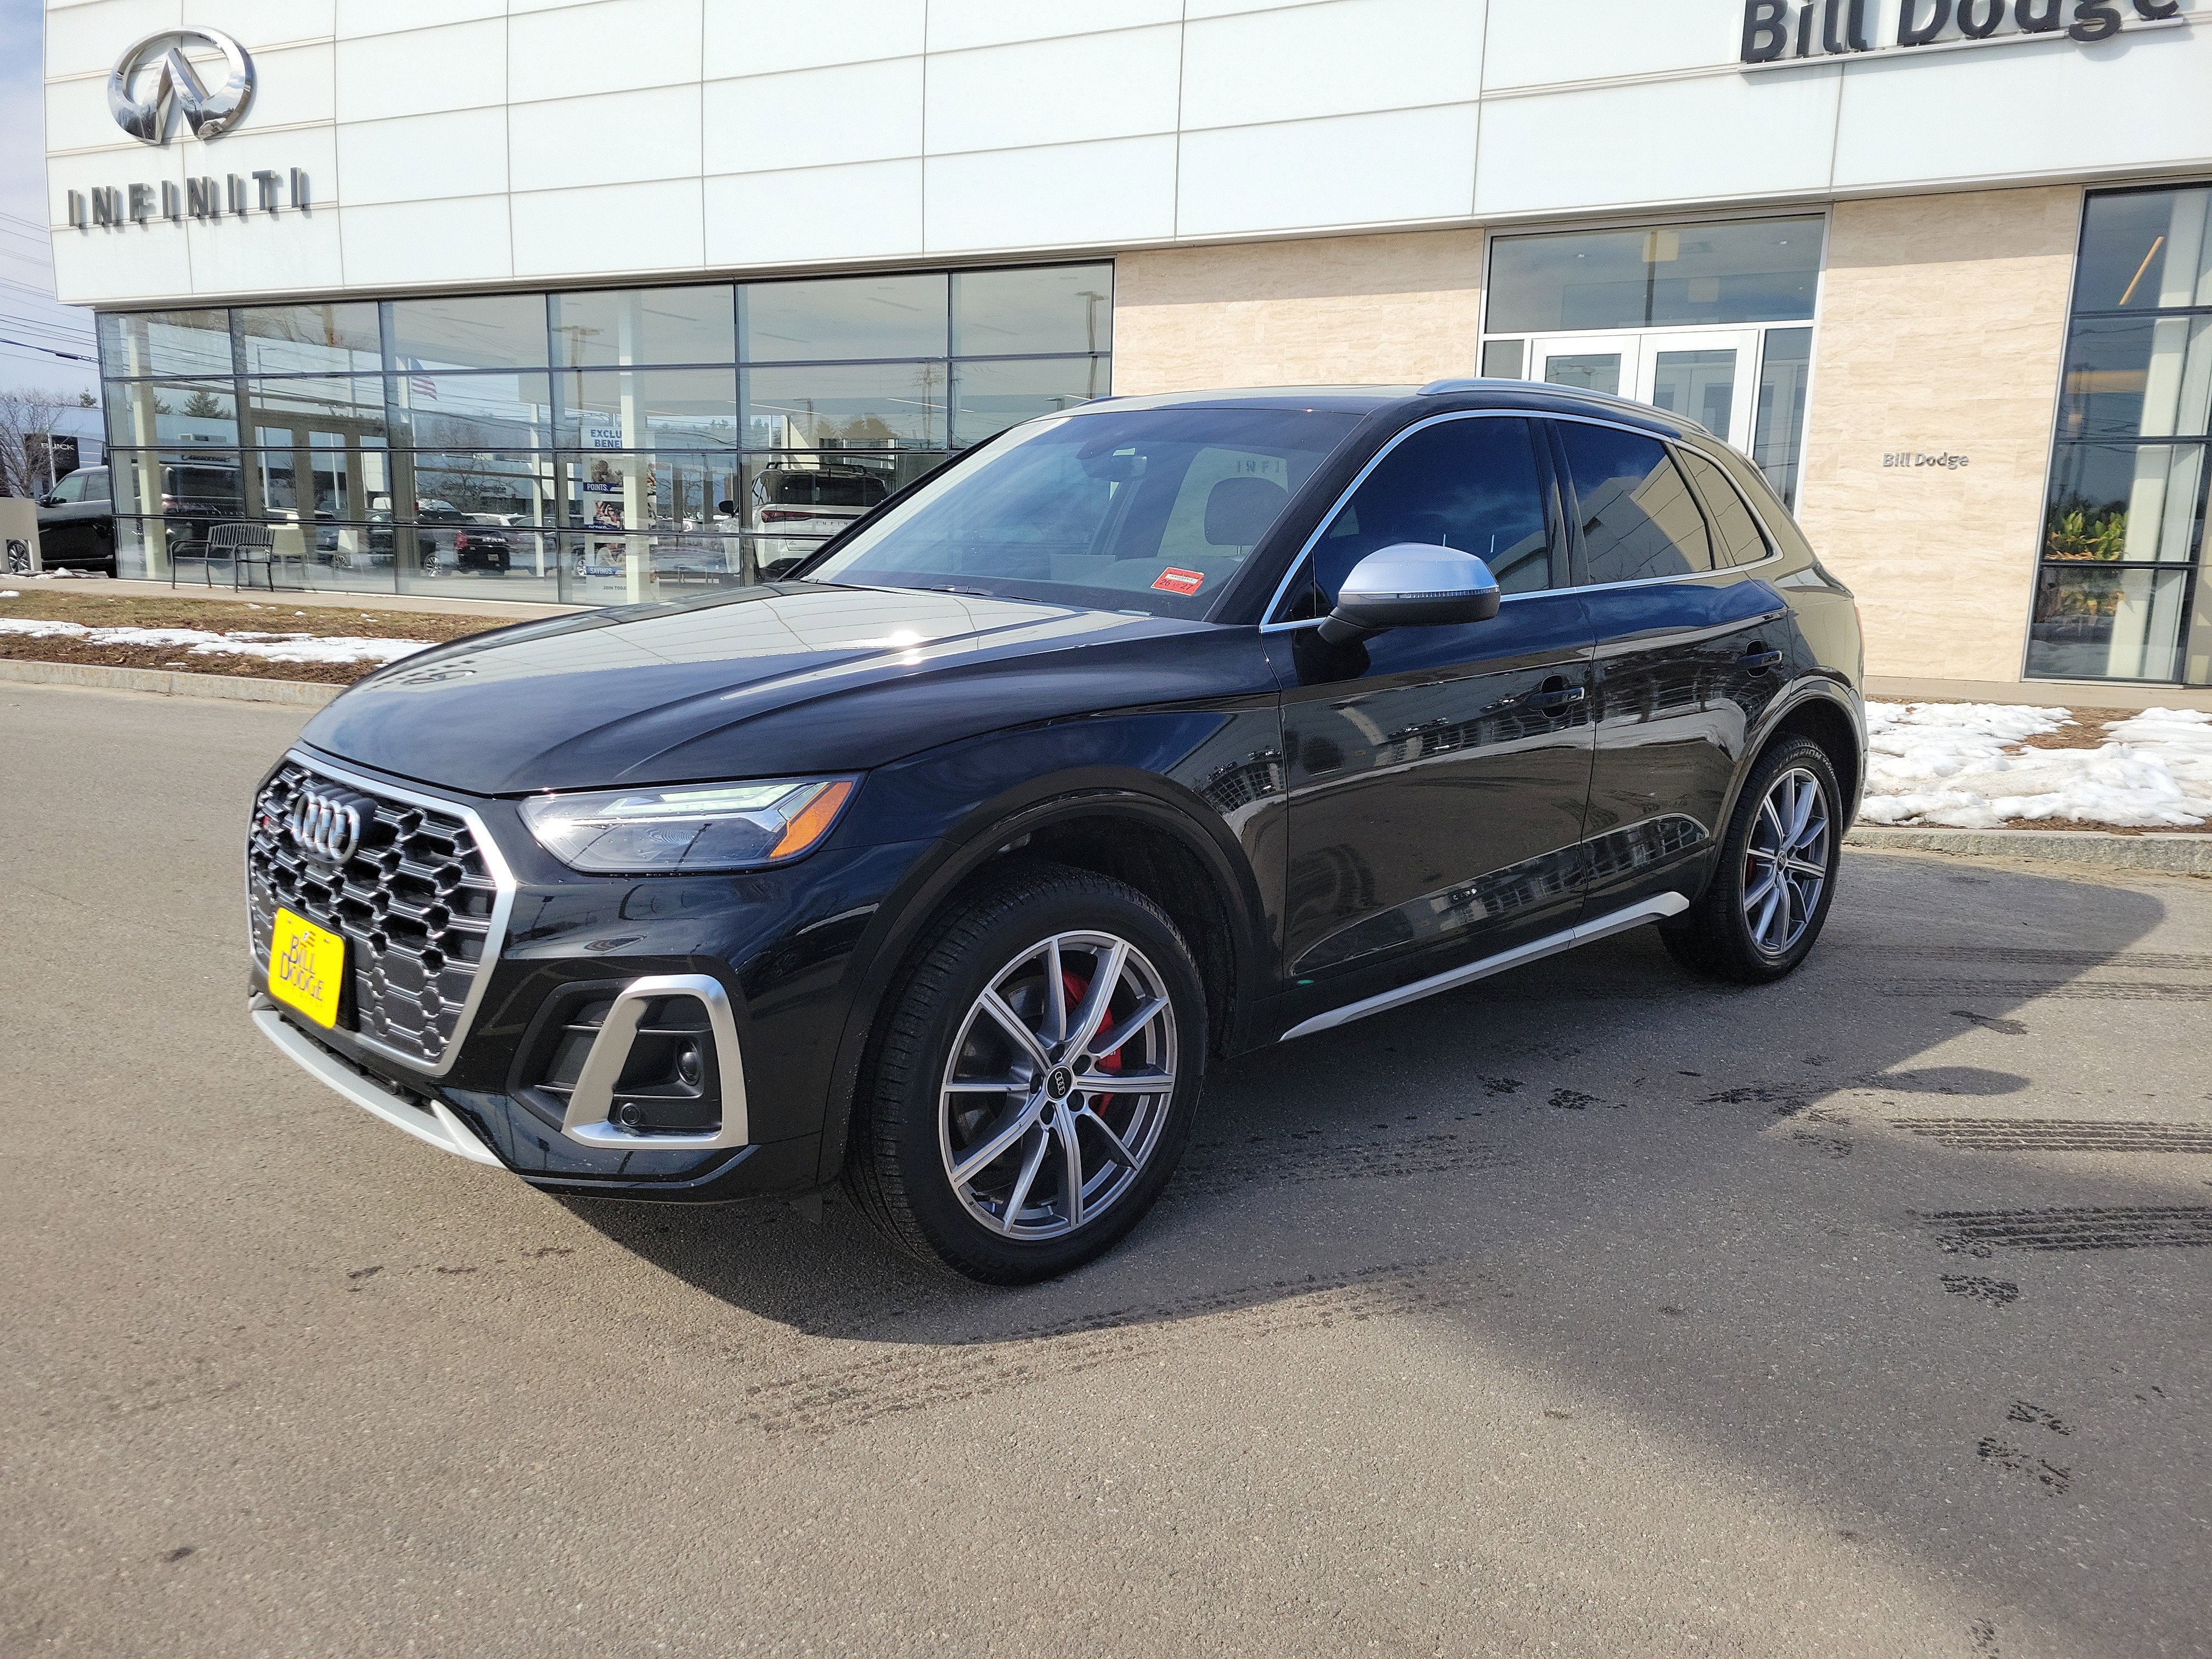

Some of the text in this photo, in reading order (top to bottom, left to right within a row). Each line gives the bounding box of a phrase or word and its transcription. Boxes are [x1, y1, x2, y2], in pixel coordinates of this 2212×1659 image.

[1740, 0, 1868, 63] Bill
[67, 167, 305, 228] INFINITI
[41, 442, 75, 450] BUICK
[590, 430, 622, 438] EXCLU
[1883, 452, 1969, 470] Bill Dodge
[280, 950, 324, 1002] DODGE
